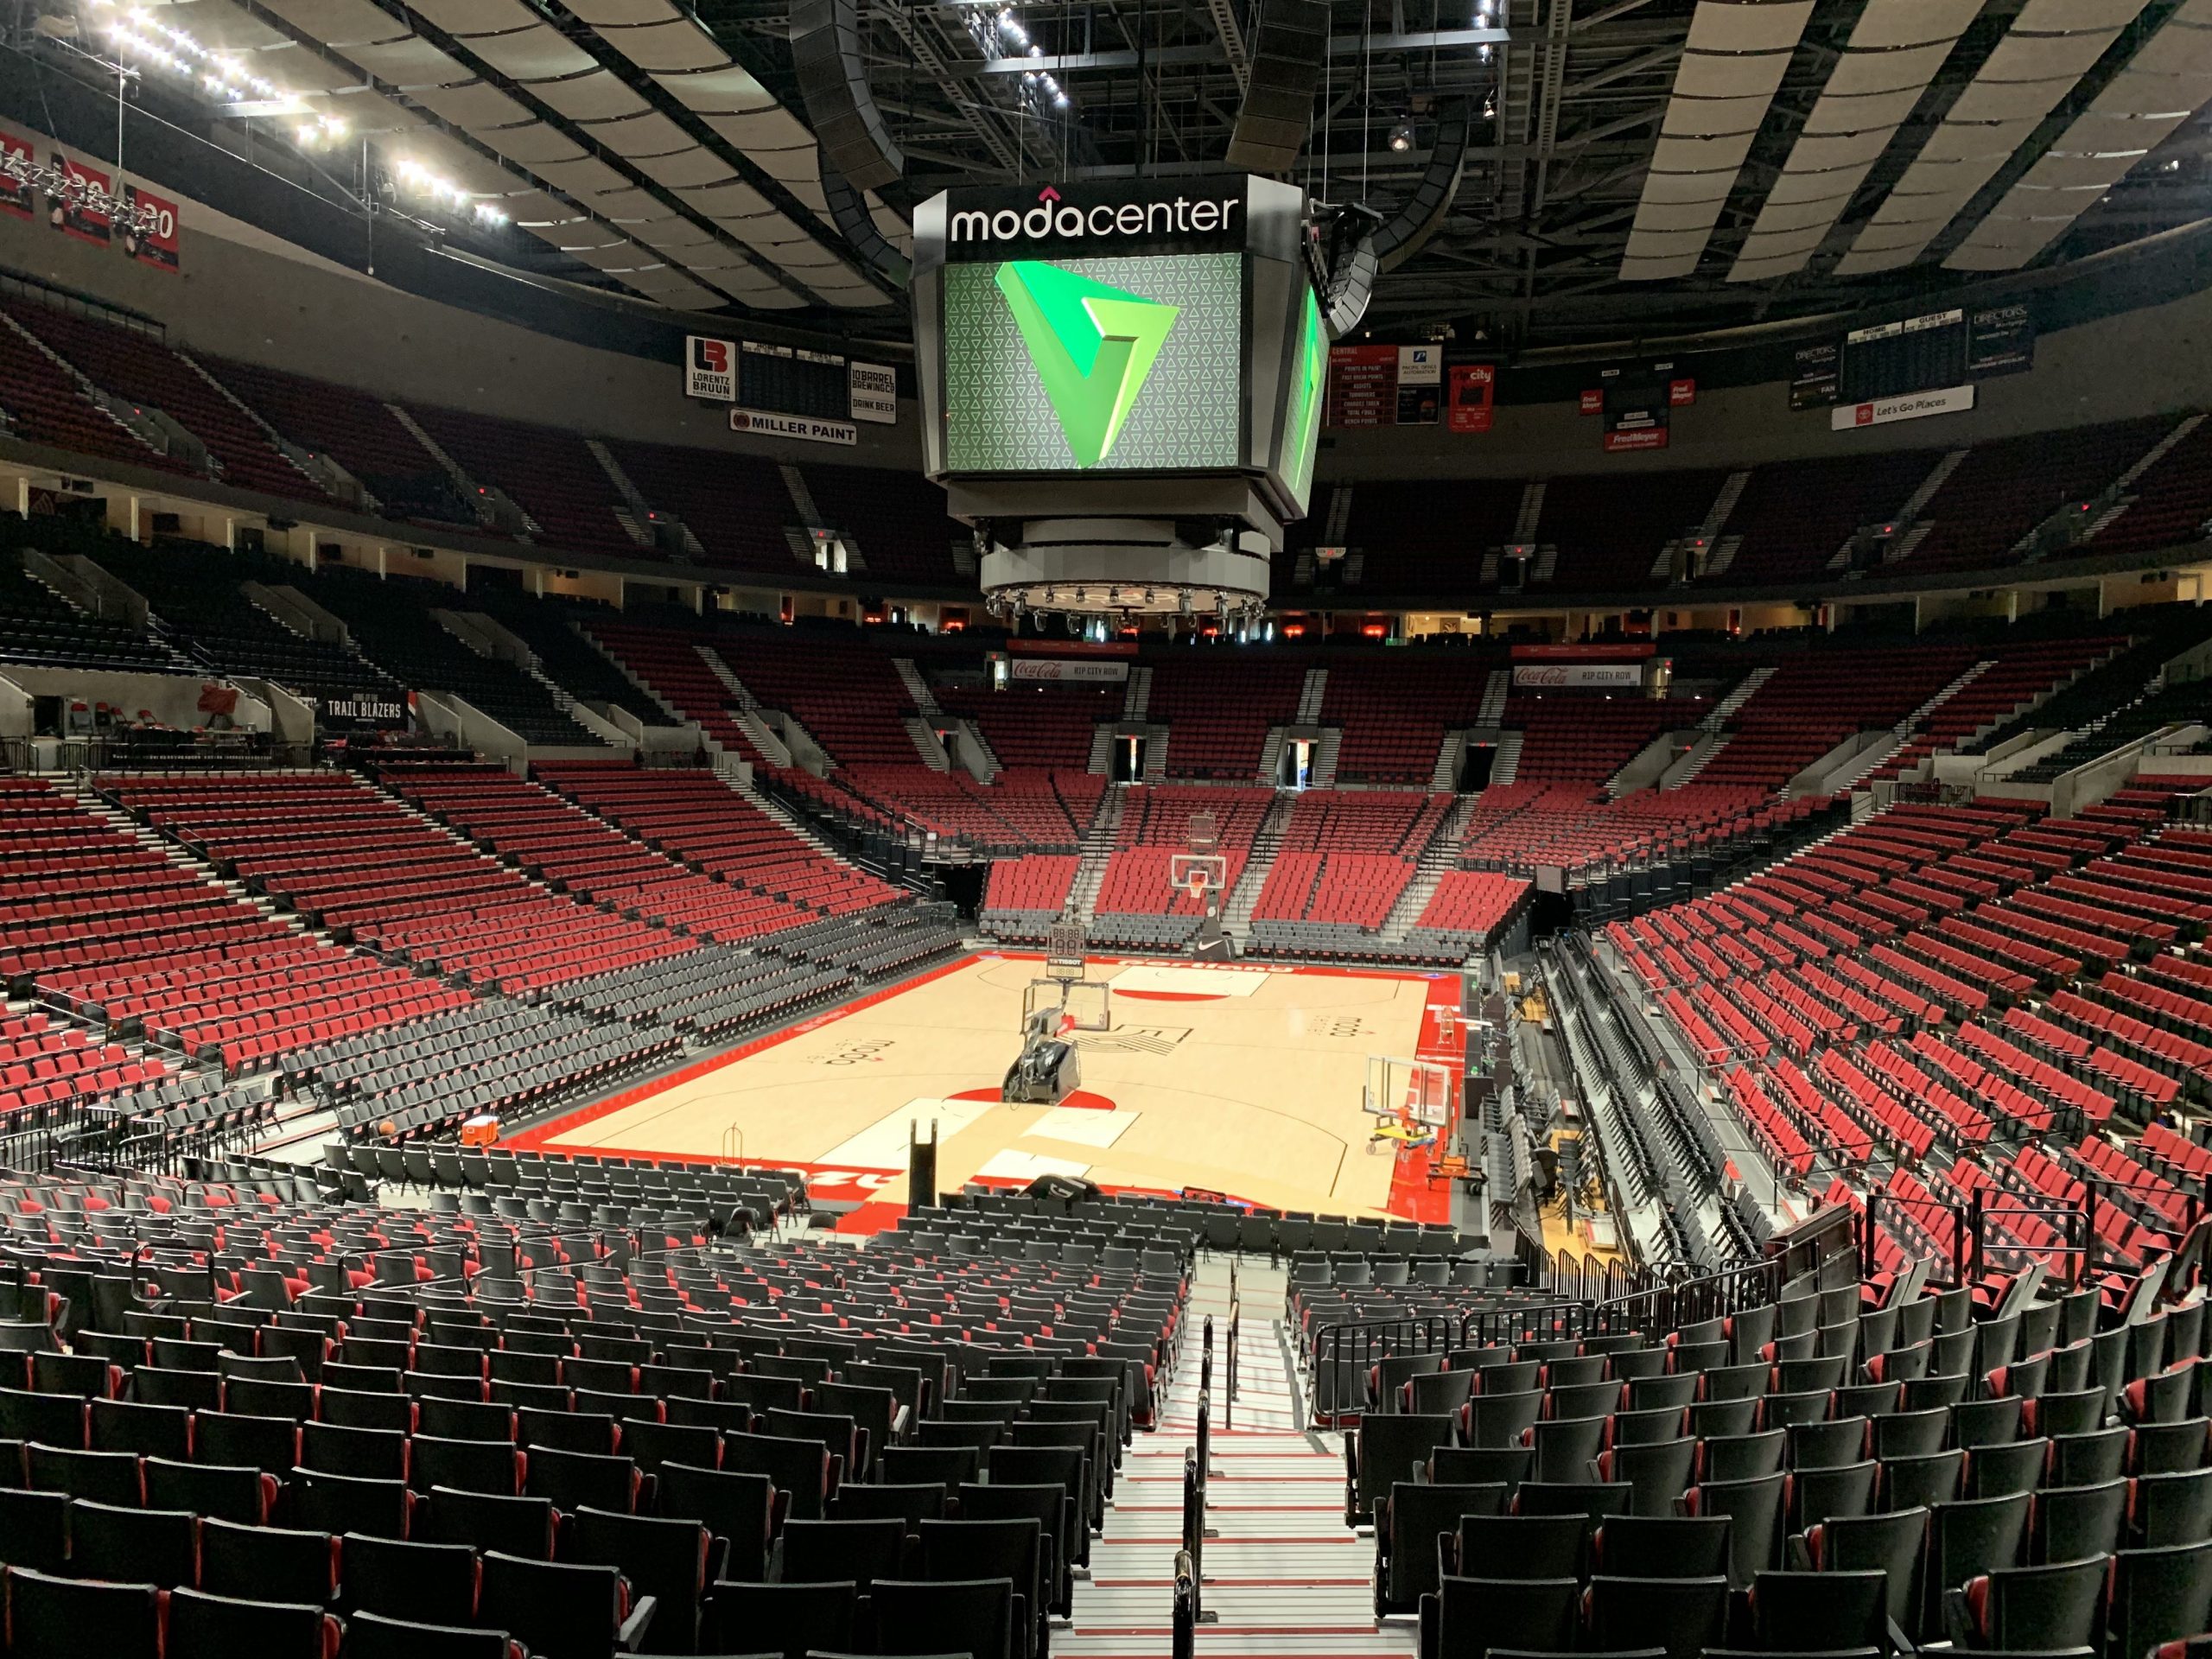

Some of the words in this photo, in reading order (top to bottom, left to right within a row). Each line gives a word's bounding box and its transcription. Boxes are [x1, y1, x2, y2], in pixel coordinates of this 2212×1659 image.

[1918, 313, 1948, 324] GUEST
[1863, 327, 1886, 335] HOME
[693, 372, 730, 385] LORENTZ
[693, 381, 730, 395] BRUUN
[1821, 385, 1836, 394] FAN
[853, 398, 874, 410] DRINK
[875, 402, 894, 412] BEER
[1877, 406, 1897, 416] Let's
[1899, 404, 1913, 412] Go
[1916, 399, 1947, 410] Places
[752, 417, 807, 435] MILLER
[812, 425, 855, 441] PAINT
[1074, 666, 1086, 675] RIP
[1087, 666, 1103, 676] CITY
[1103, 667, 1118, 677] ROW
[1582, 671, 1595, 680] RIP
[1597, 671, 1613, 680] CITY
[1615, 671, 1631, 680] ROW
[327, 700, 358, 717] TRAIL
[360, 702, 401, 719] BLAZERS
